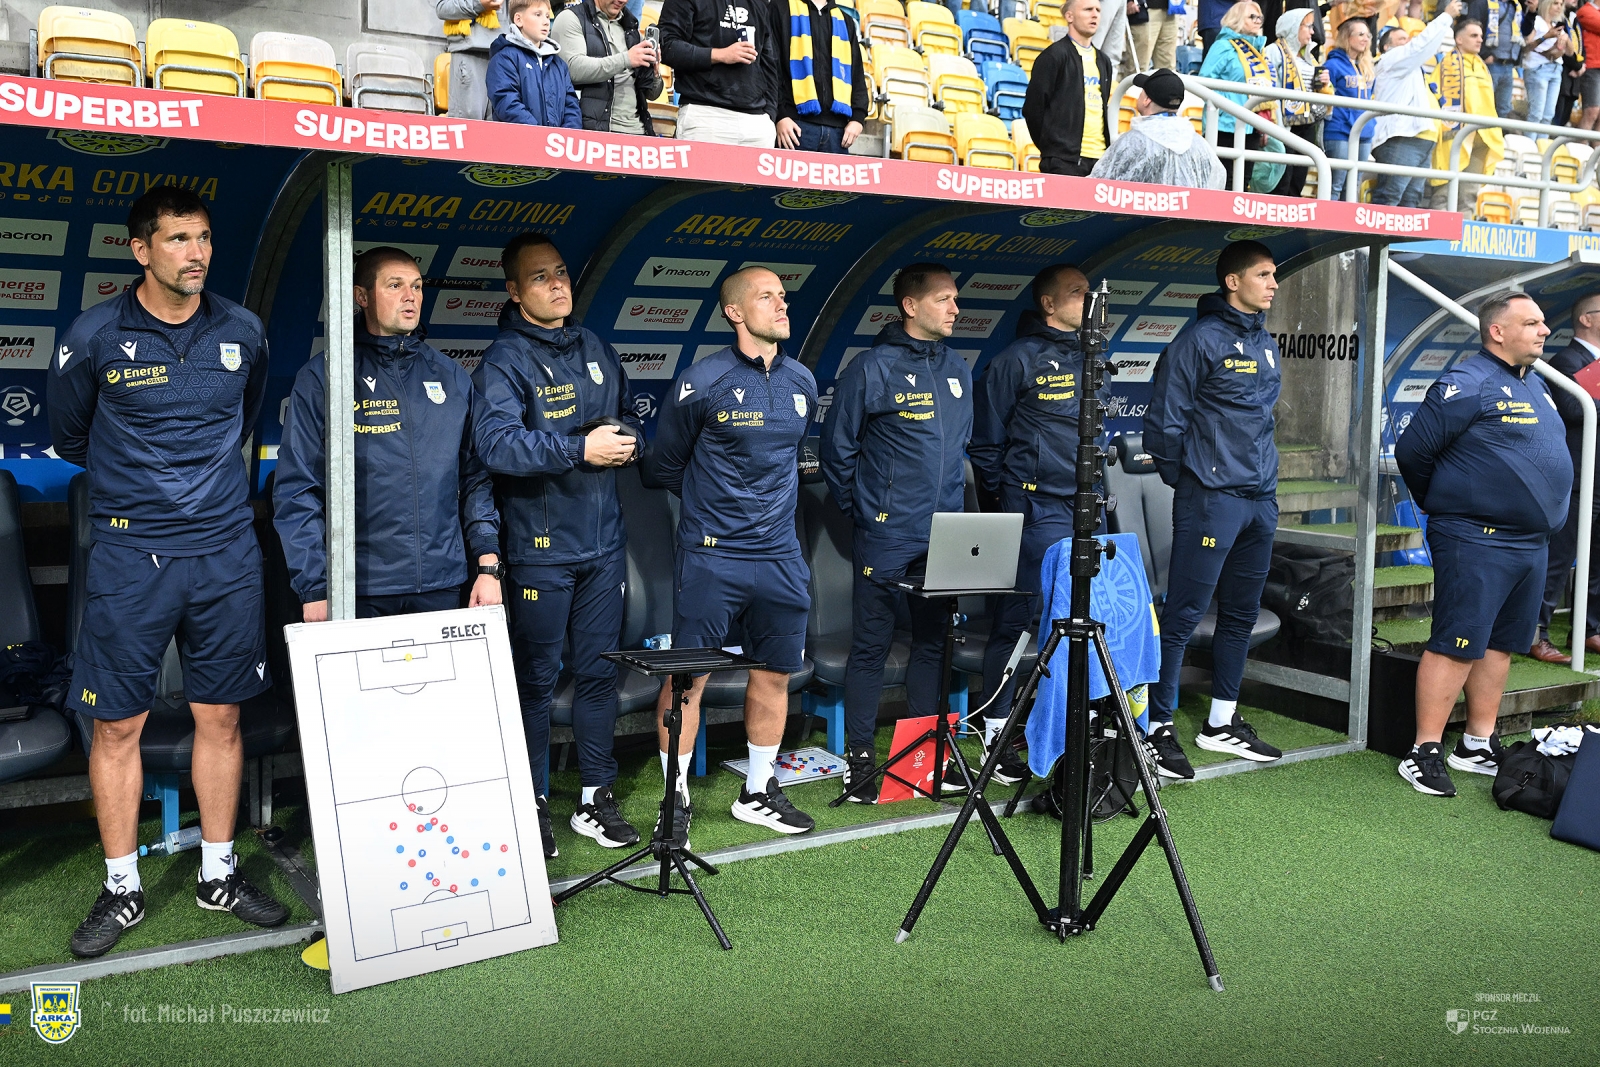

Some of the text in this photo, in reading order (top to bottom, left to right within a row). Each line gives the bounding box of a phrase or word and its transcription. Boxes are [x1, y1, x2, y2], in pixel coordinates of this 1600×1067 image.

[0, 82, 203, 128] SUPERBET
[294, 109, 467, 150] SUPERBET
[545, 133, 692, 170] SUPERBET
[757, 153, 882, 186] SUPERBET
[0, 161, 74, 191] RKA
[936, 168, 1045, 200] SUPERBET
[1094, 182, 1190, 212] SUPERBET
[360, 191, 576, 225] ARKA GDYNIA
[1232, 195, 1317, 223] SUPERBET
[1355, 206, 1431, 232] SUPERBET
[673, 213, 854, 243] ARKA GDYNIA
[923, 230, 1078, 256] ARKA GDYNIA
[1134, 244, 1204, 263] ARKA
[665, 268, 710, 277] macron
[0, 280, 46, 293] nerga
[970, 281, 1022, 291] SUPERBET
[1163, 291, 1201, 299] SUPERBE
[465, 299, 504, 311] Energ
[647, 306, 689, 317] Energa
[884, 313, 904, 322] Ene
[959, 316, 992, 326] Energa
[1148, 322, 1177, 331] Energa
[439, 349, 485, 359] GDYNI
[620, 353, 667, 363] GDYNIA
[461, 359, 480, 369] spo
[636, 361, 664, 371] sport
[1117, 360, 1151, 368] GDYNIA
[1234, 360, 1257, 368] Energa
[124, 365, 167, 379] Energa
[1047, 373, 1074, 382] Energa
[544, 383, 574, 395] Energa
[906, 392, 933, 401] Energa
[1038, 390, 1075, 401] SUPERBET
[362, 399, 398, 409] Energa
[543, 404, 577, 419] UPERBET
[731, 410, 763, 420] Energa
[898, 410, 935, 421] SUPERBET
[353, 422, 401, 434] SUPERBET
[875, 512, 889, 523] JF
[534, 536, 550, 548] MB
[703, 535, 718, 547] RF
[1202, 536, 1216, 548] DS
[523, 588, 539, 601] MB
[441, 623, 487, 639] SELECT
[1455, 637, 1469, 649] TP
[81, 688, 97, 707] KM
